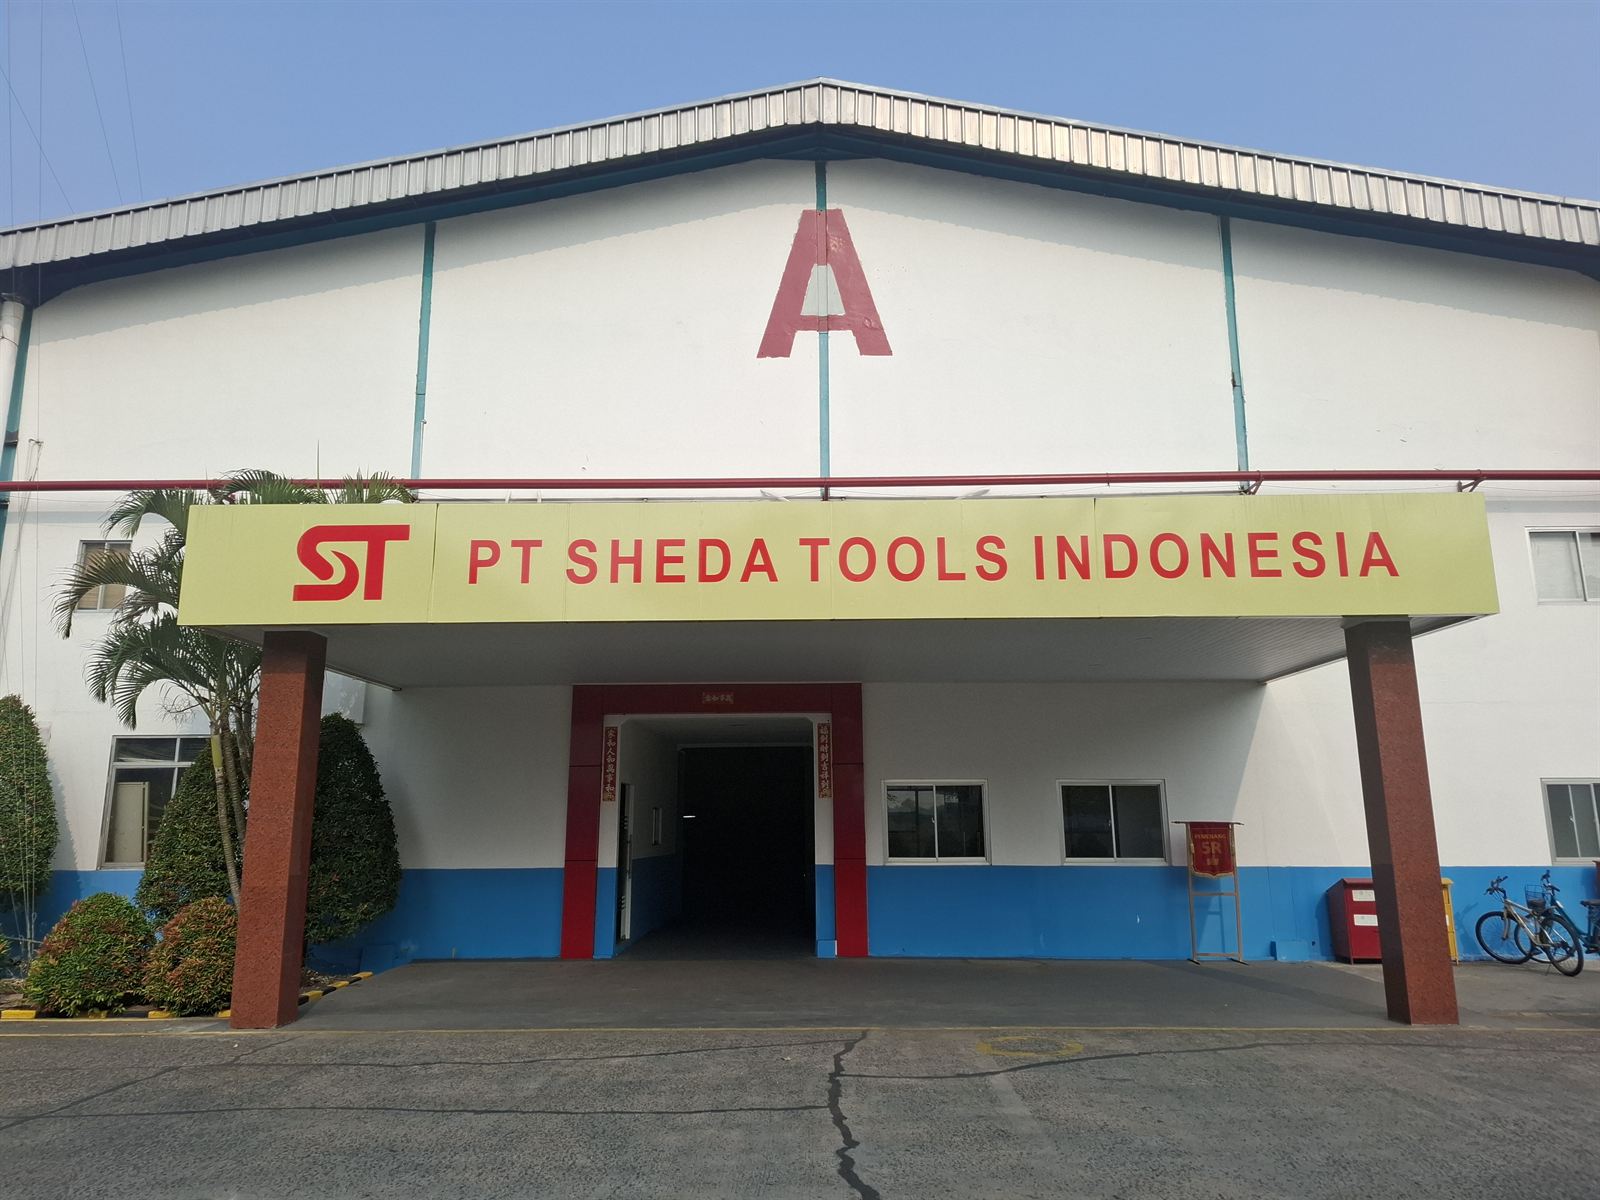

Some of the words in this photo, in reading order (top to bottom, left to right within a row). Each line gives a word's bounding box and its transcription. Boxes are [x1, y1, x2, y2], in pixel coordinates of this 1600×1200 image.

[757, 209, 892, 358] A
[293, 524, 410, 601] ST
[468, 540, 543, 585] PT
[566, 537, 778, 585] SHEDA
[800, 535, 1008, 583] TOOLS
[1034, 532, 1399, 581] INDONESIA
